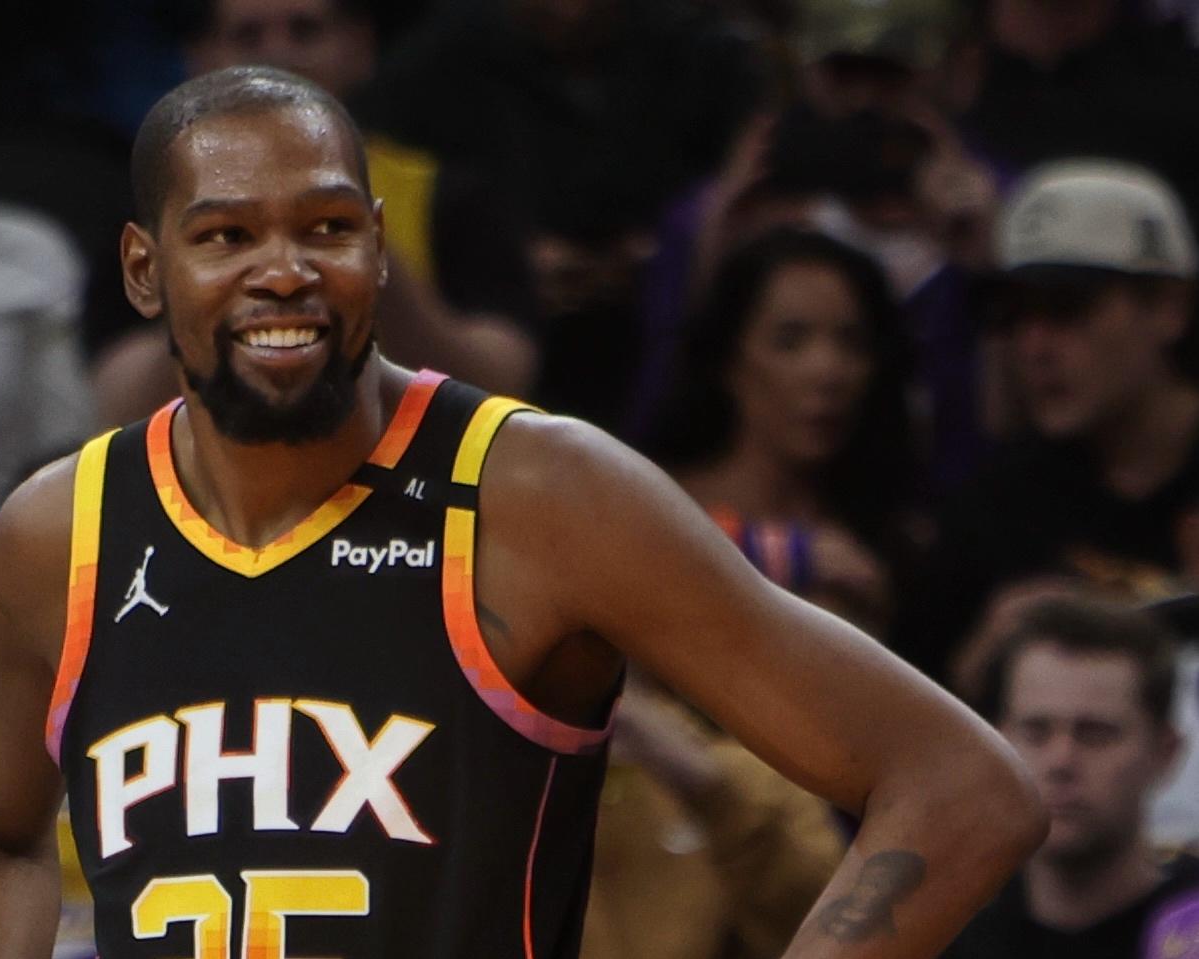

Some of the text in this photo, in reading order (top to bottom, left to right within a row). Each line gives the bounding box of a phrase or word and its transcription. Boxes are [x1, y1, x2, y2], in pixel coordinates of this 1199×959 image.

[404, 478, 426, 500] AL
[331, 539, 435, 574] PayPal
[87, 697, 438, 859] PHX
